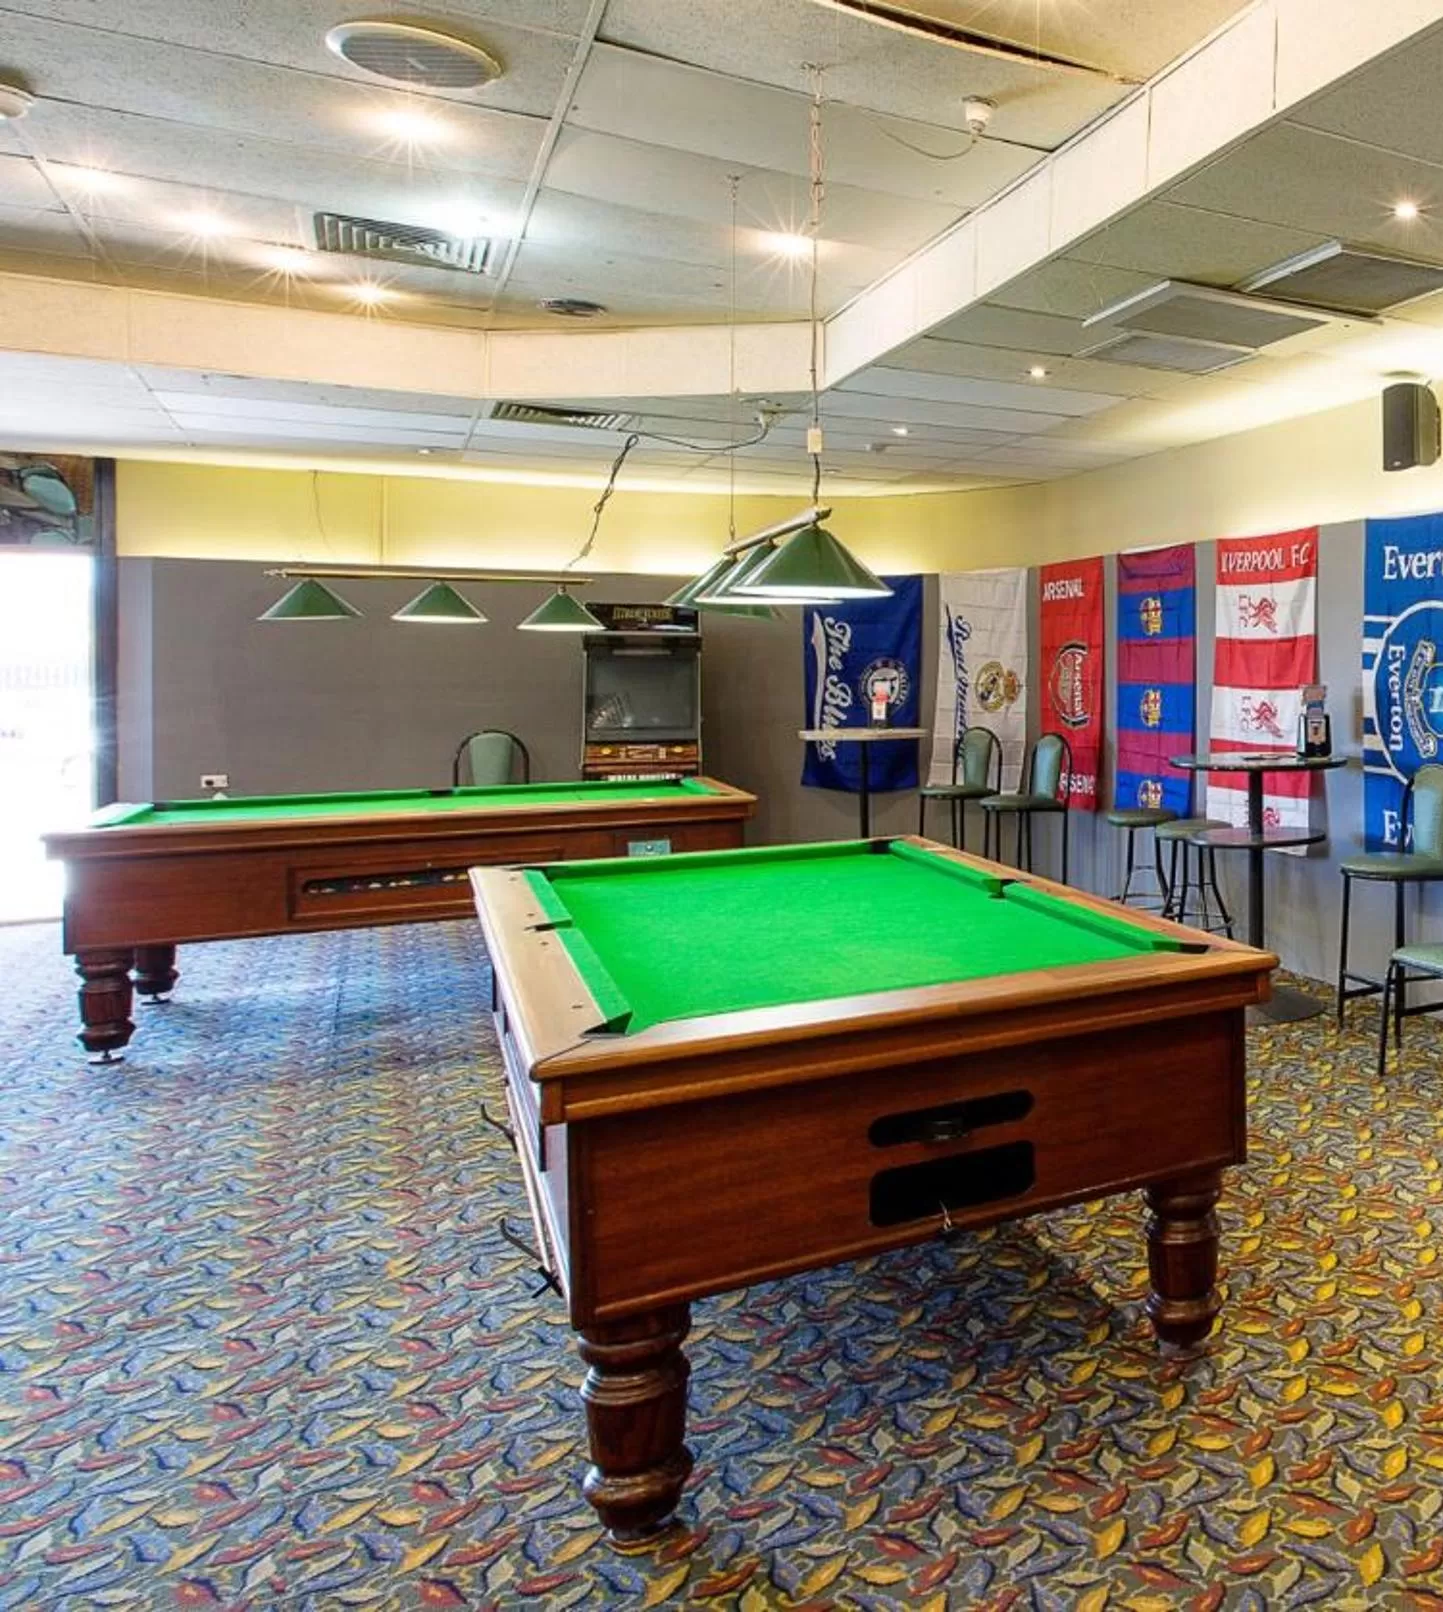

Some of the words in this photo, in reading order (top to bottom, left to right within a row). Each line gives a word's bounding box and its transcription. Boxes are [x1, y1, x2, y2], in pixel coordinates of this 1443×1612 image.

[1290, 542, 1311, 568] FC
[824, 616, 852, 671] The
[954, 615, 972, 675] Real
[818, 674, 853, 761] Blus
[1387, 644, 1406, 751] Everton
